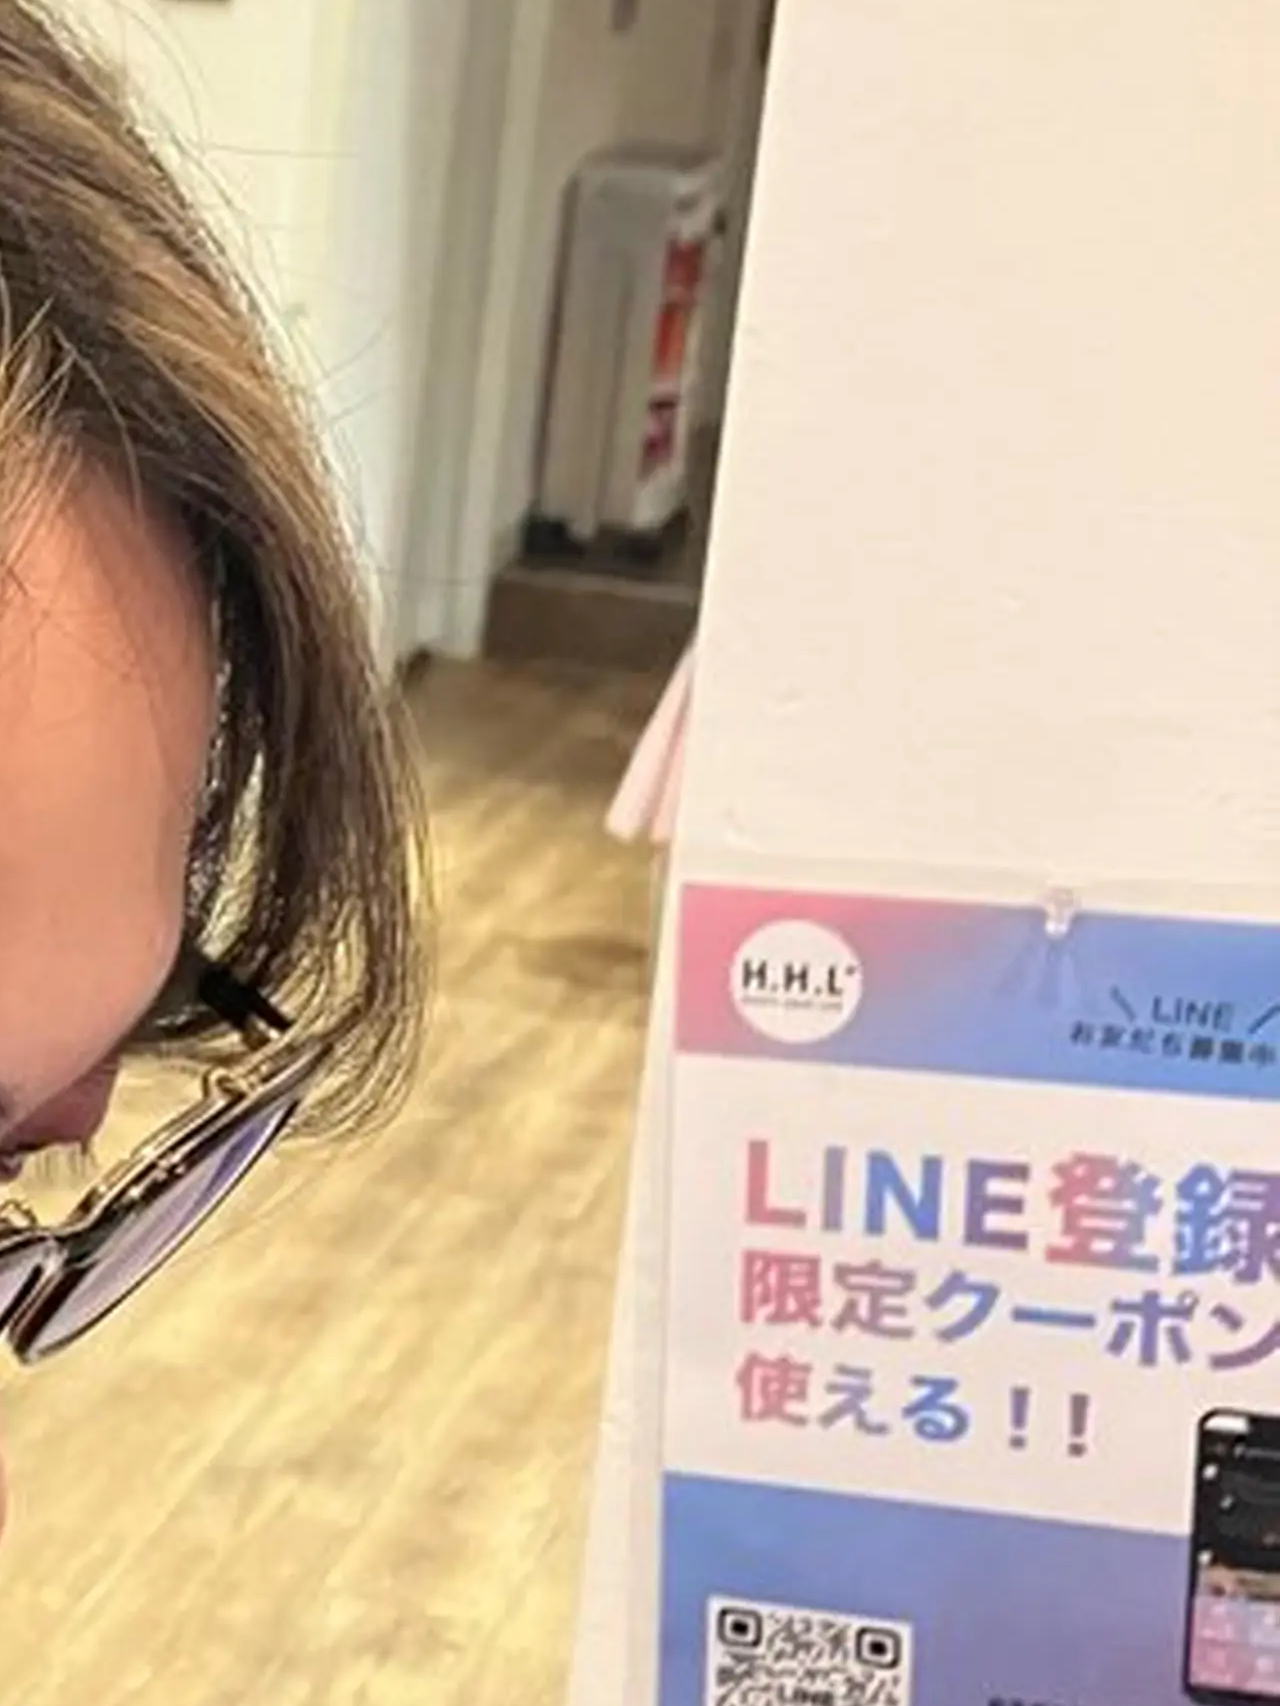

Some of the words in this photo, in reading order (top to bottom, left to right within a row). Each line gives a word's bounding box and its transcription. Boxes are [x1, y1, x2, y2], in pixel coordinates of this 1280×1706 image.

[1152, 996, 1236, 1032] LINE
[744, 1139, 1280, 1286] LINE登録
[739, 1249, 1280, 1372] 限定クーポン
